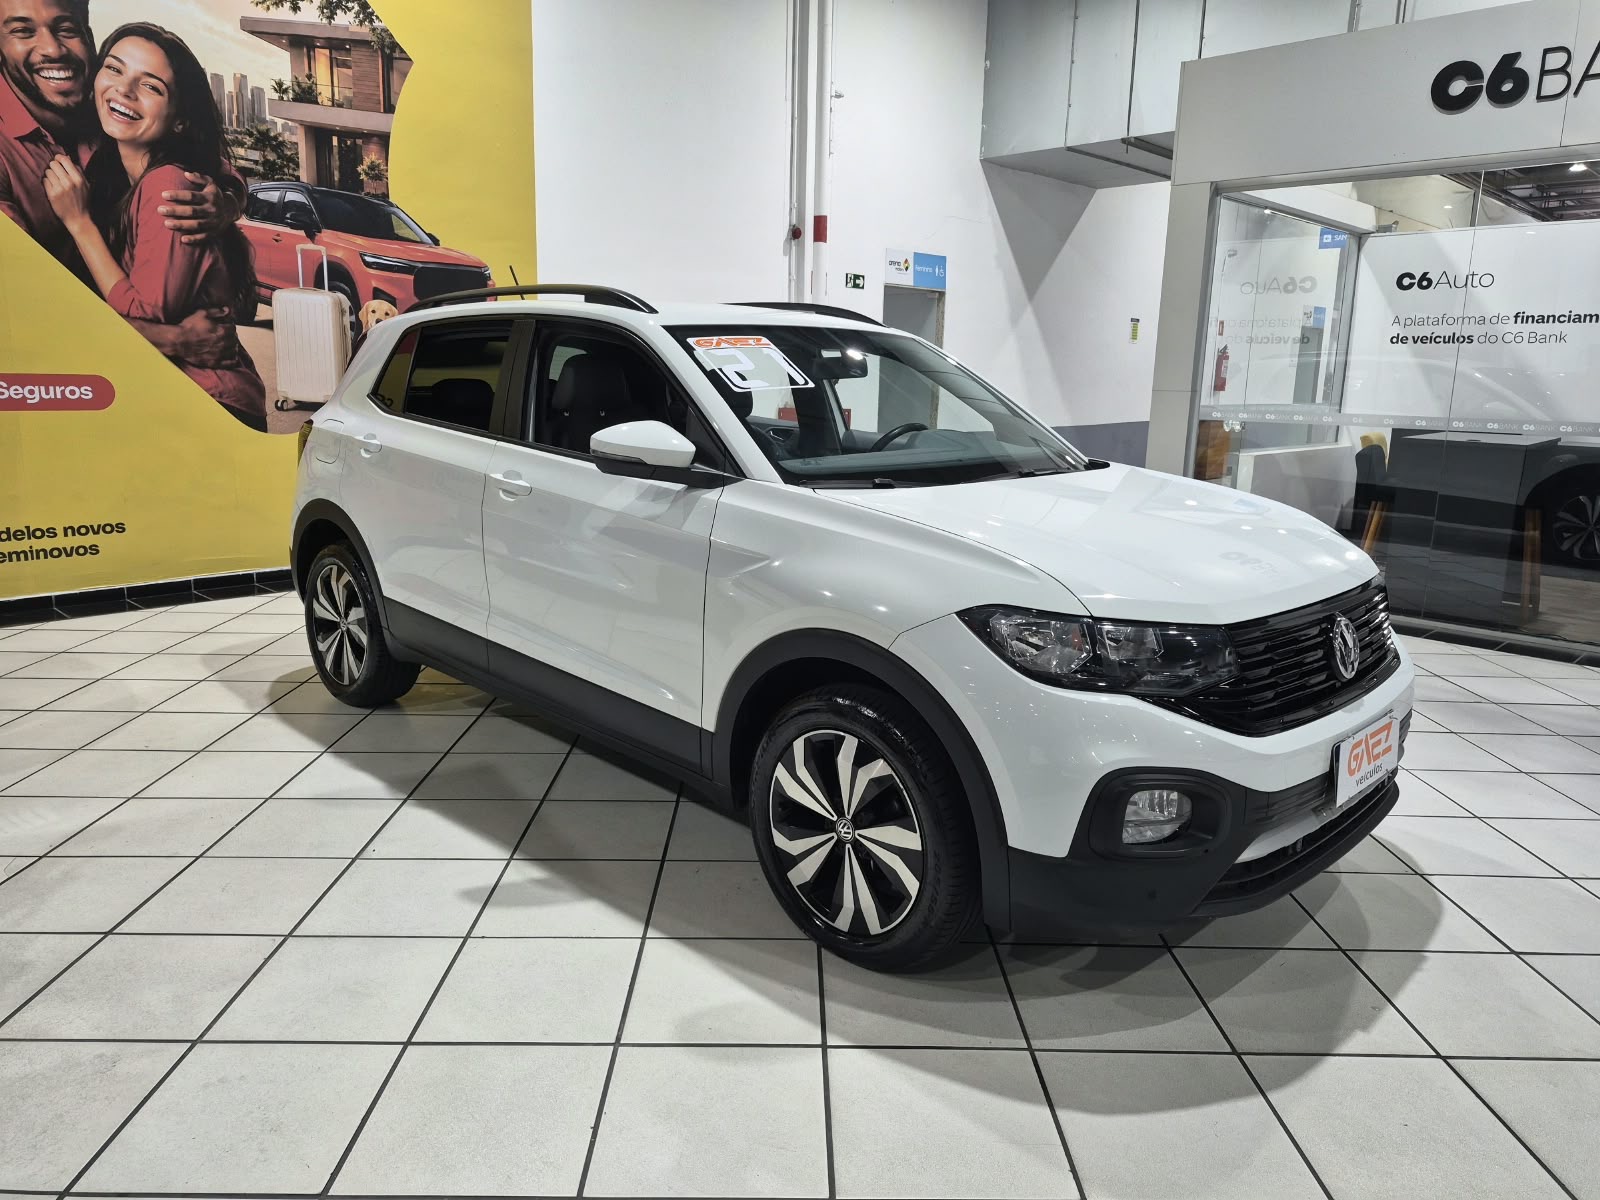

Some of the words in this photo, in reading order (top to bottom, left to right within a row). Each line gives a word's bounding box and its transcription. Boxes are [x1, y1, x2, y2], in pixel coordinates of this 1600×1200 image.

[1396, 270, 1495, 292] C6Auto
[1391, 315, 1401, 327] A
[1403, 313, 1486, 329] plataforma
[1489, 312, 1510, 325] de
[1513, 310, 1600, 325] financiam
[1389, 333, 1408, 345] de
[1412, 332, 1474, 345] veículos
[1477, 331, 1498, 345] do
[1501, 331, 1524, 345] C6
[1527, 330, 1568, 345] Bank
[0, 380, 94, 404] Seguros
[63, 522, 126, 538] novos
[1347, 719, 1394, 777] GAEZ
